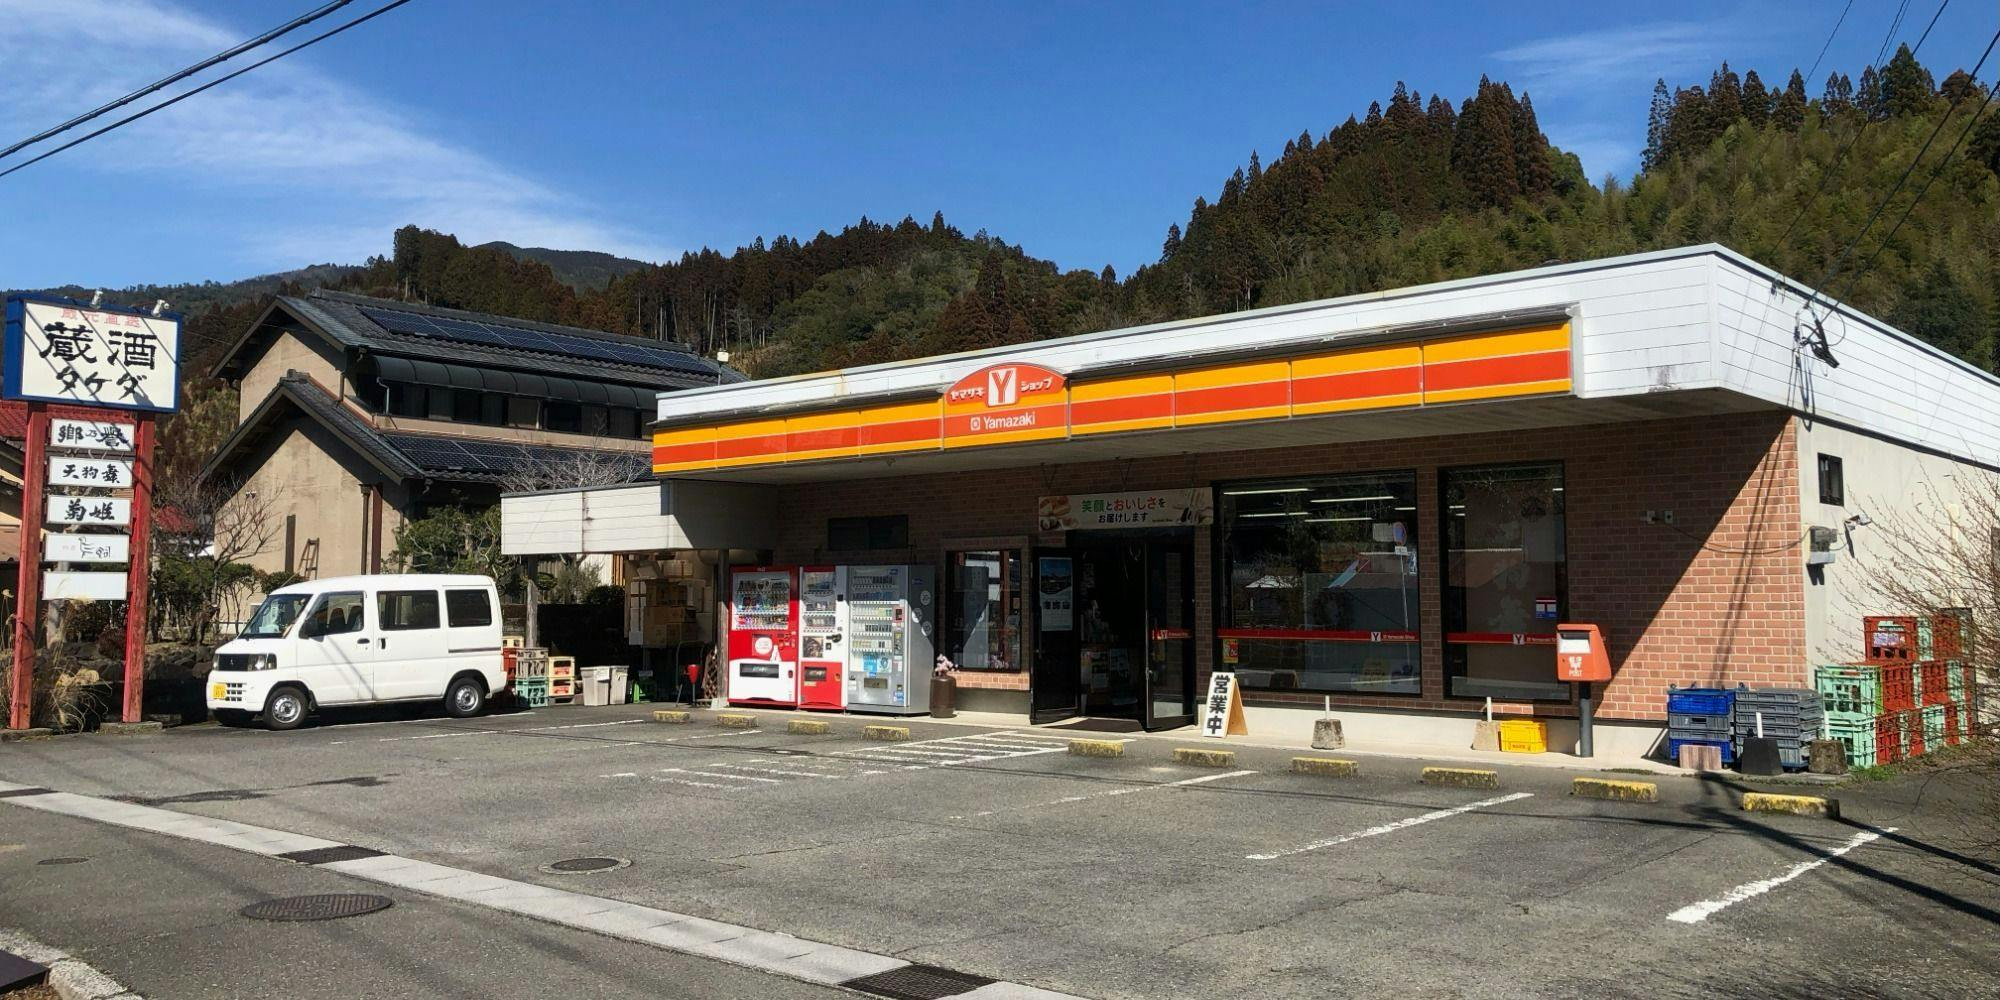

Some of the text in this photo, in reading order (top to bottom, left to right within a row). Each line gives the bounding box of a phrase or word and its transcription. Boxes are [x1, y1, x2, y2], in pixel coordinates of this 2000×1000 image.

[56, 366, 147, 400] タケダ
[991, 369, 1014, 404] Y
[1020, 376, 1053, 392] ショップ
[983, 411, 1036, 430] Yamazaki
[64, 498, 115, 521] 菊姫
[1081, 496, 1167, 513] 笑顔とおいしさを
[1098, 512, 1149, 524] お届けします
[1207, 674, 1230, 734] 営業中
